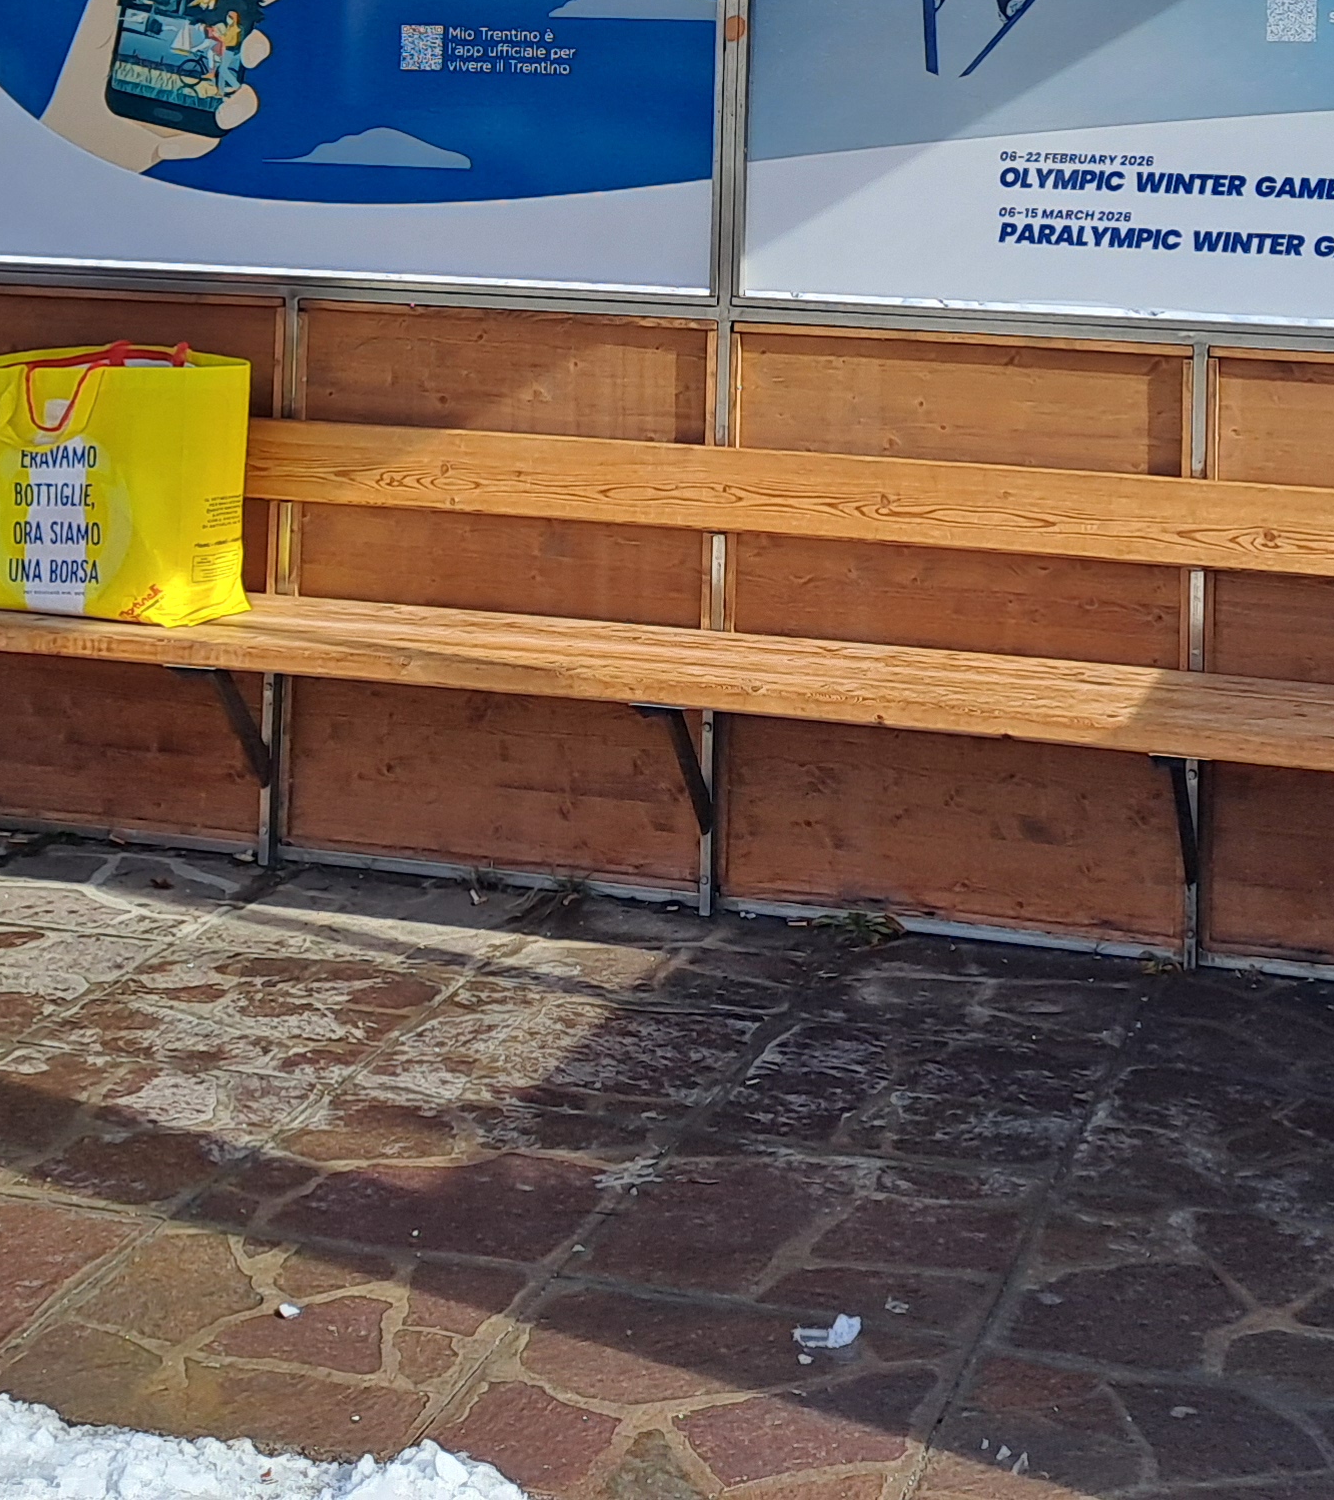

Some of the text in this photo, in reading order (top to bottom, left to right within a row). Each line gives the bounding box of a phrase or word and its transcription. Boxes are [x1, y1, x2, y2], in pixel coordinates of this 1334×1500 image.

[448, 27, 554, 42] Mio Trentino è
[448, 43, 576, 61] l'app ufficiale per
[447, 60, 570, 75] vivere il Trentino
[1044, 153, 1118, 165] FEBRUARY
[1120, 155, 1154, 166] 2026
[1000, 167, 1126, 191] OLYMPIC
[1136, 171, 1247, 197] WINTER
[998, 207, 1038, 218] 06-15
[1041, 209, 1095, 221] MARCH
[998, 222, 1182, 251] PARALYMPIC
[1192, 230, 1305, 257] WINTER
[21, 445, 97, 469] ERAVAMO
[14, 482, 95, 510] BOTTIGLIE,
[14, 521, 101, 546] ORA SIAMO
[9, 558, 99, 584] UNA BORSA
